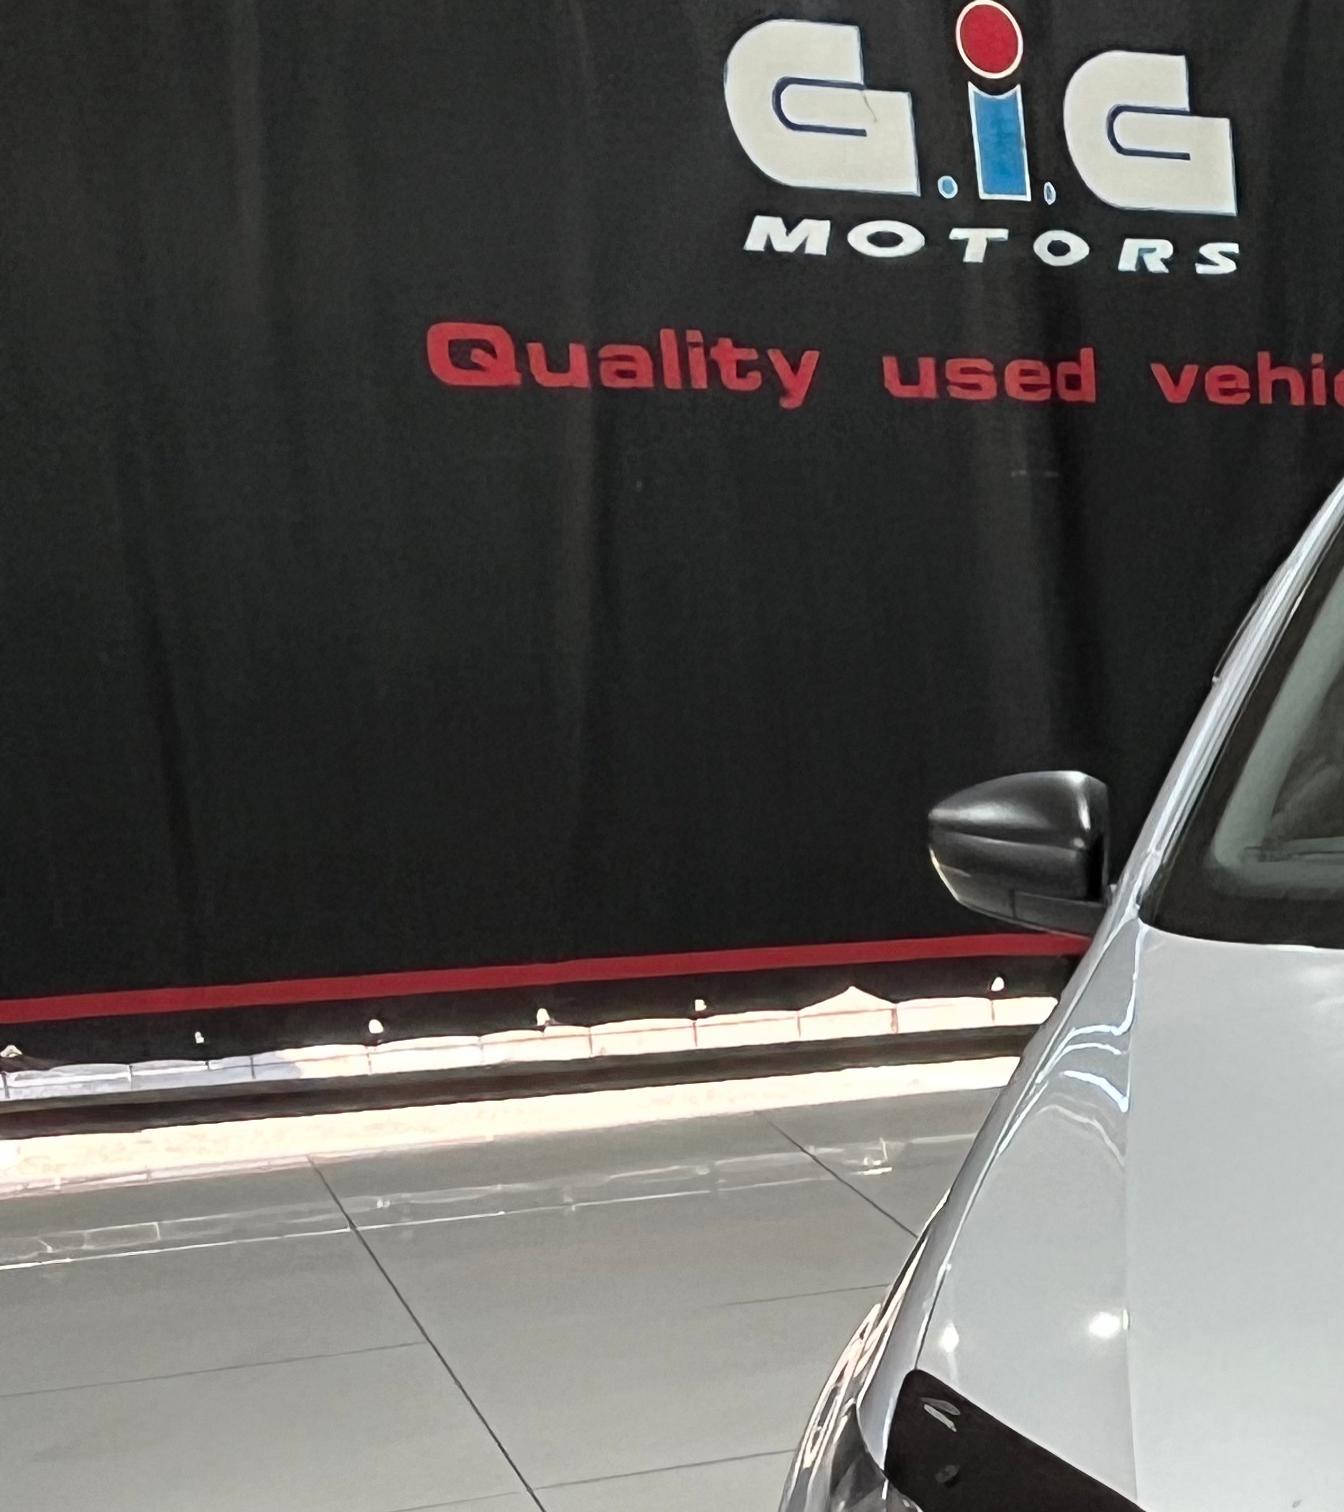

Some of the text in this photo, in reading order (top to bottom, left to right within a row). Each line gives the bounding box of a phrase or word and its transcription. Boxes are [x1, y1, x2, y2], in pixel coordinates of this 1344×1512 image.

[743, 214, 1241, 276] MOTORS
[426, 321, 820, 410] Quality
[883, 346, 1097, 404] used
